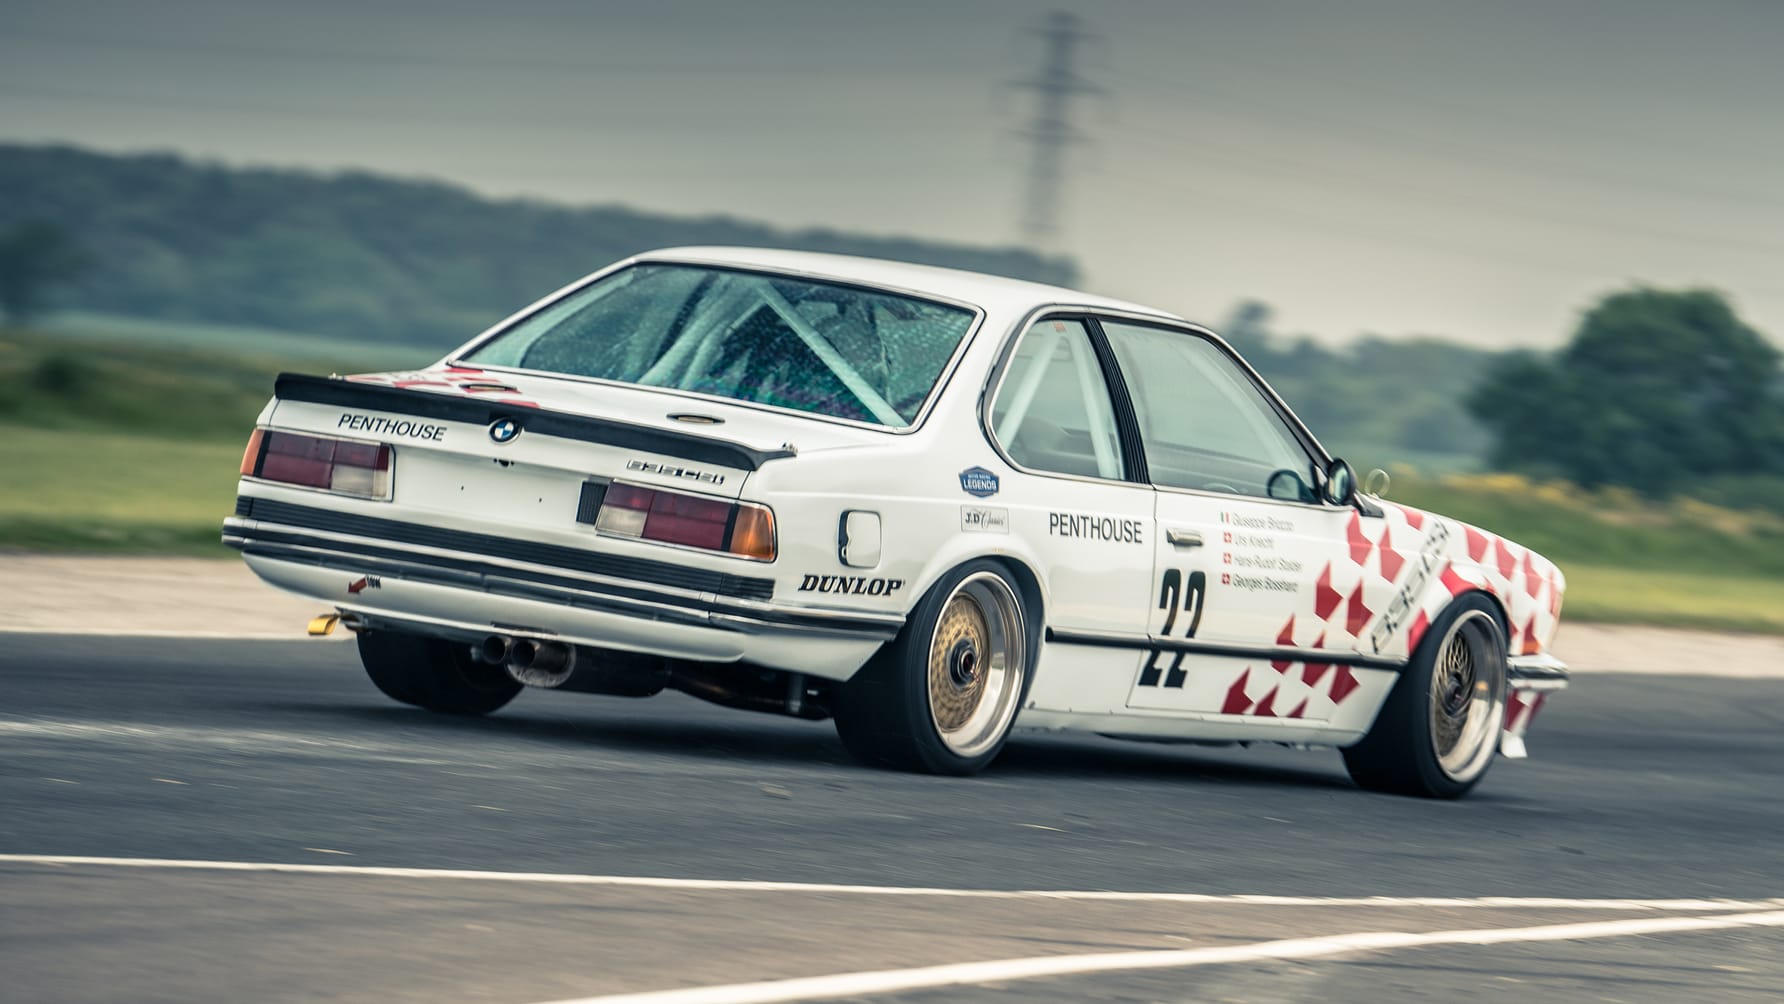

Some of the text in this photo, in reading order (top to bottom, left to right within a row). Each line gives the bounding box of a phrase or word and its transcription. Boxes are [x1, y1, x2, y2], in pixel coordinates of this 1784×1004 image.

[338, 413, 447, 442] PENTHOUSE
[963, 479, 997, 491] LEGENDS
[1049, 512, 1143, 544] PENTHOUSE
[798, 574, 902, 596] DUNLOP
[1138, 568, 1206, 689] 22
